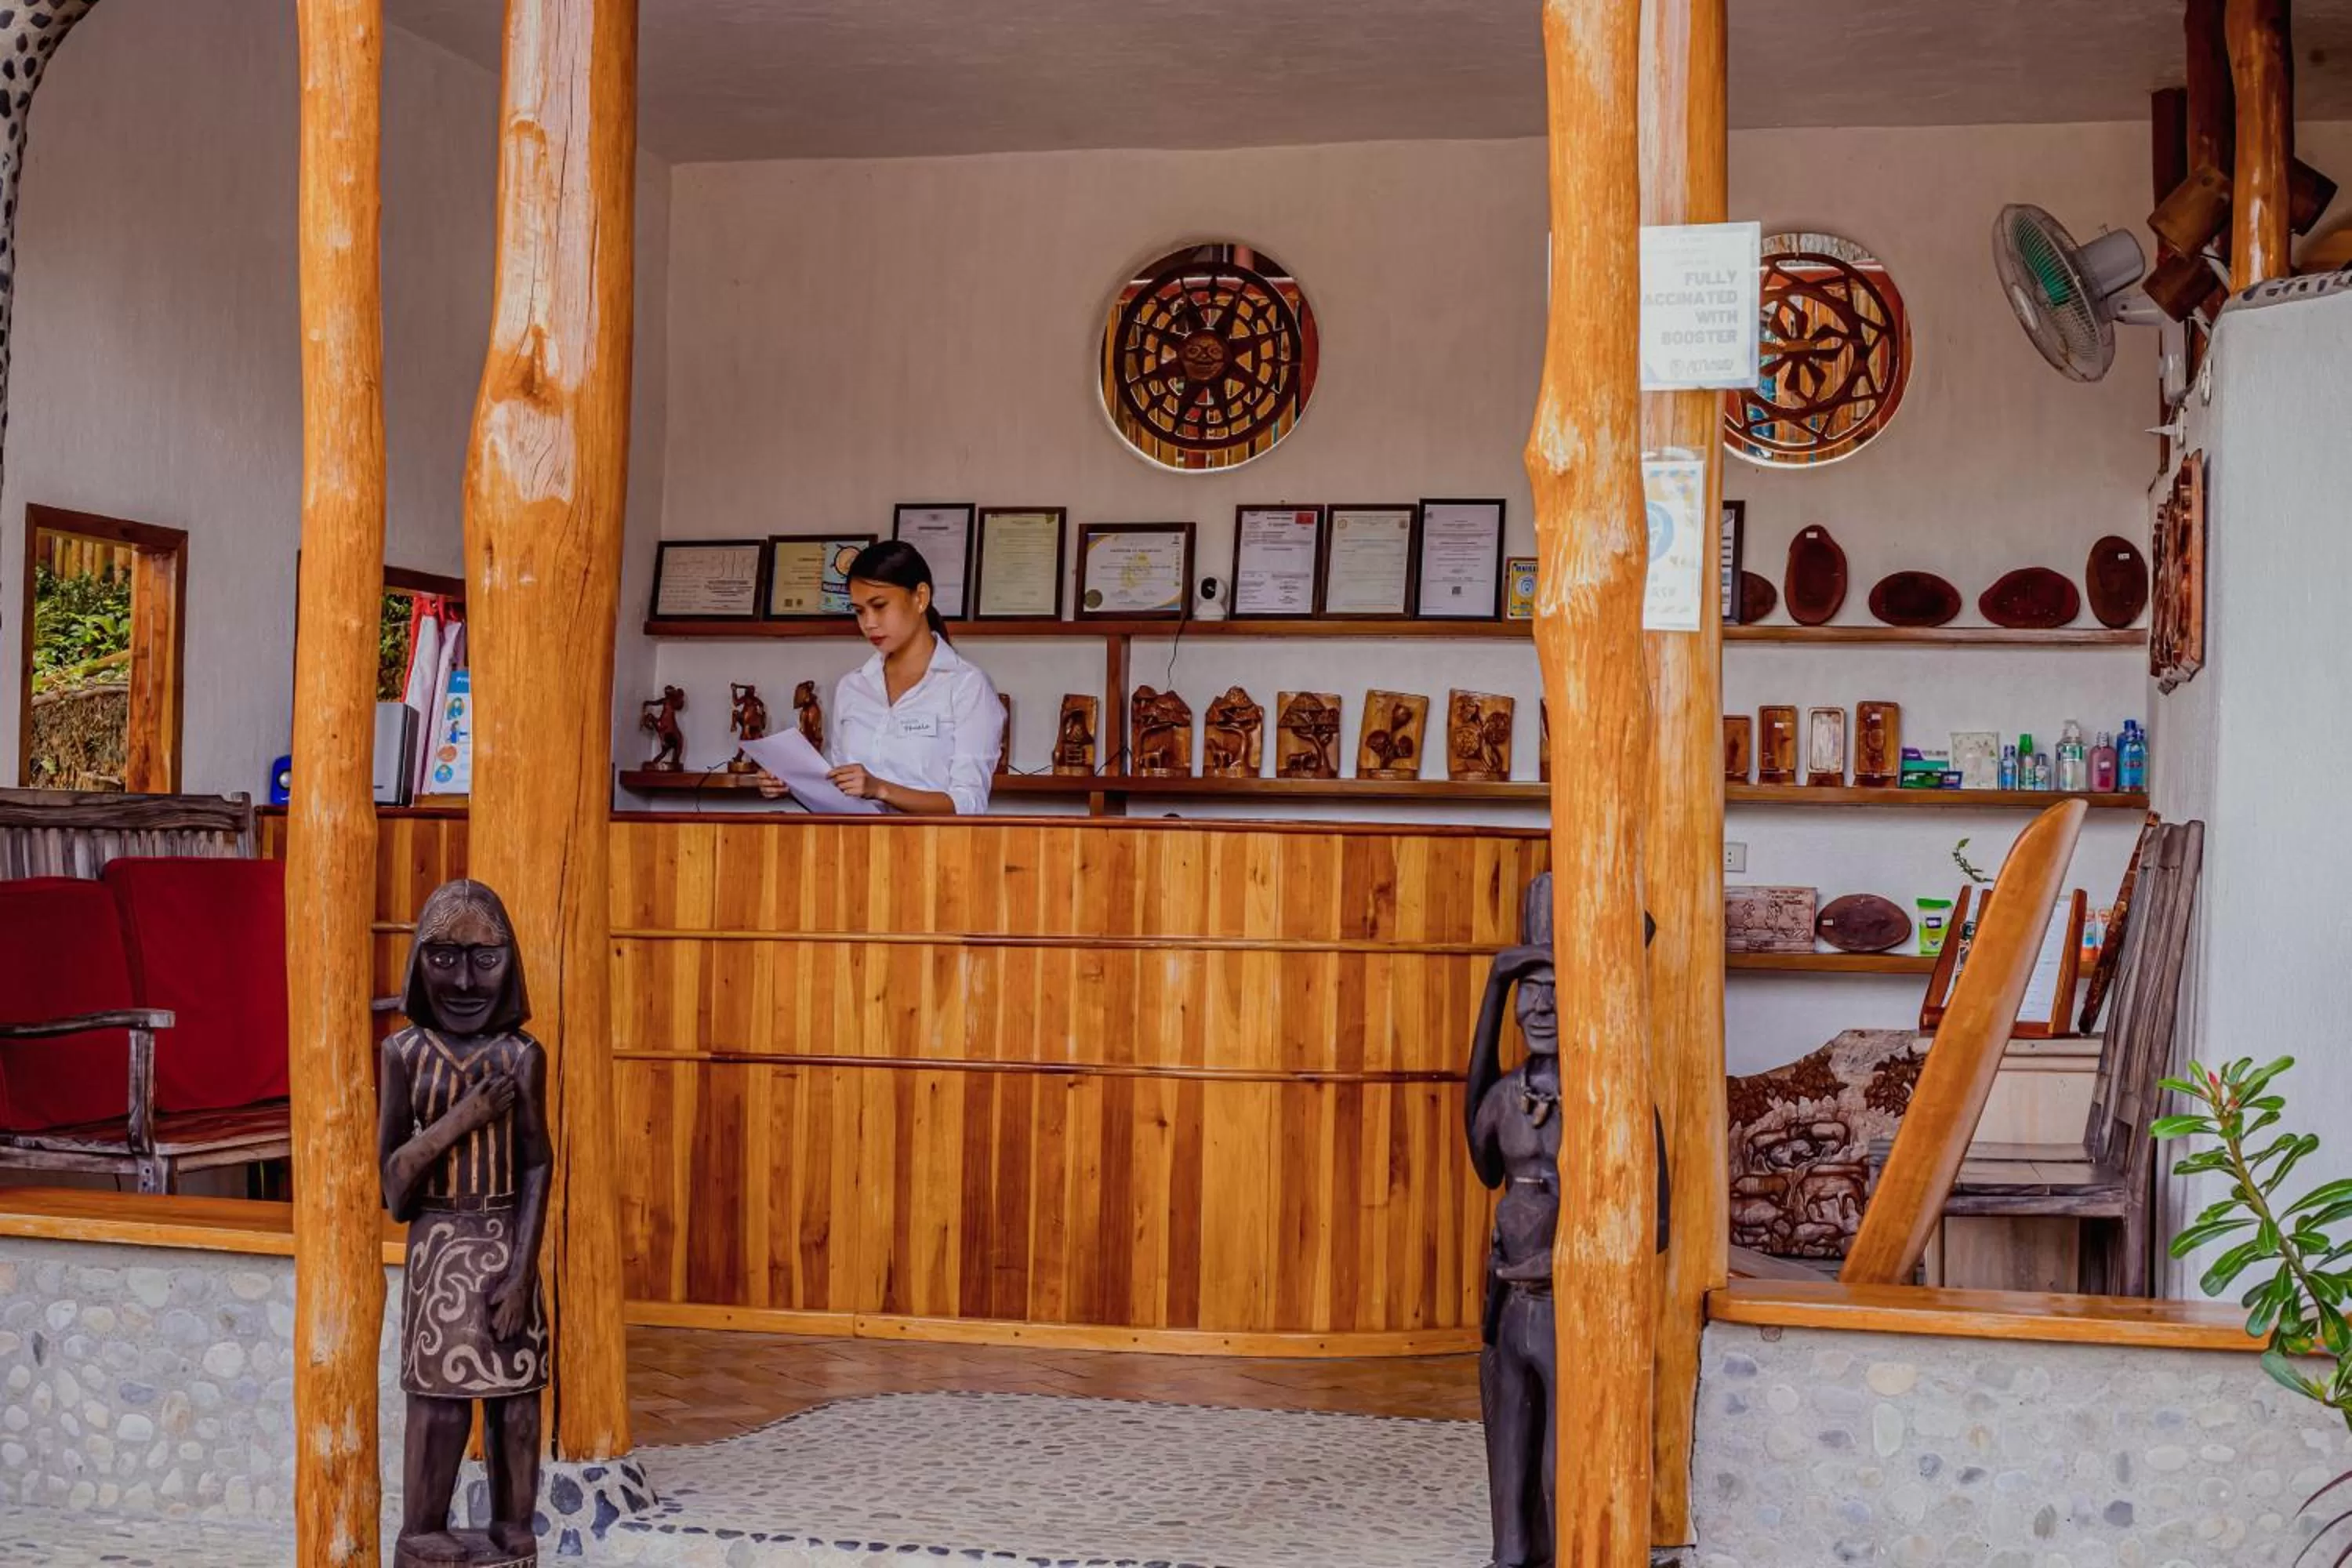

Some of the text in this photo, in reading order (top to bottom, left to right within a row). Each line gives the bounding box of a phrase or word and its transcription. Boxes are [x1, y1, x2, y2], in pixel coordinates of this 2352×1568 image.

[1685, 270, 1738, 285] FULLY
[1643, 289, 1738, 307] ACCINATED
[1695, 310, 1738, 325] WITH
[1661, 329, 1738, 346] BOOSTER
